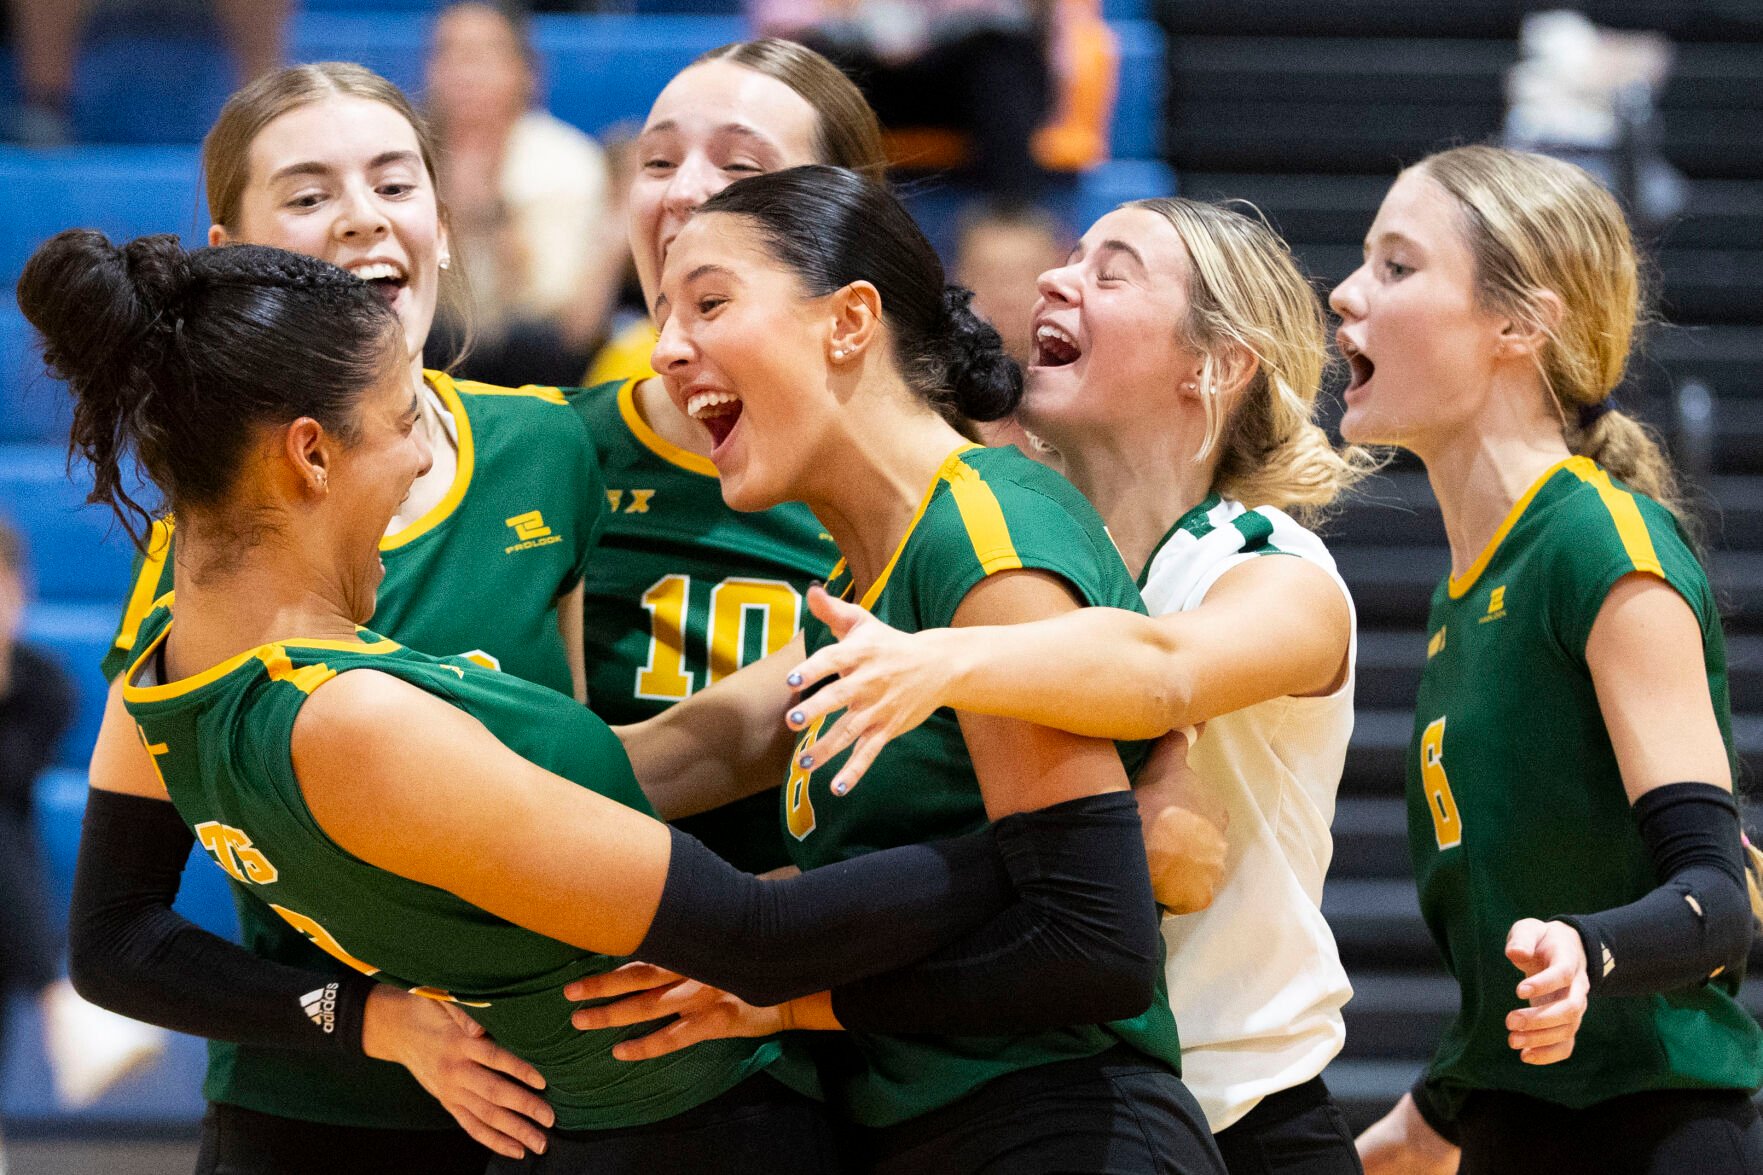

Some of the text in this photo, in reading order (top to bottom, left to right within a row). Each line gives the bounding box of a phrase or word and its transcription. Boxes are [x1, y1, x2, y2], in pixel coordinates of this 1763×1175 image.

[634, 573, 802, 701] 10
[1420, 714, 1462, 852] 6
[320, 982, 339, 1034] adidas
